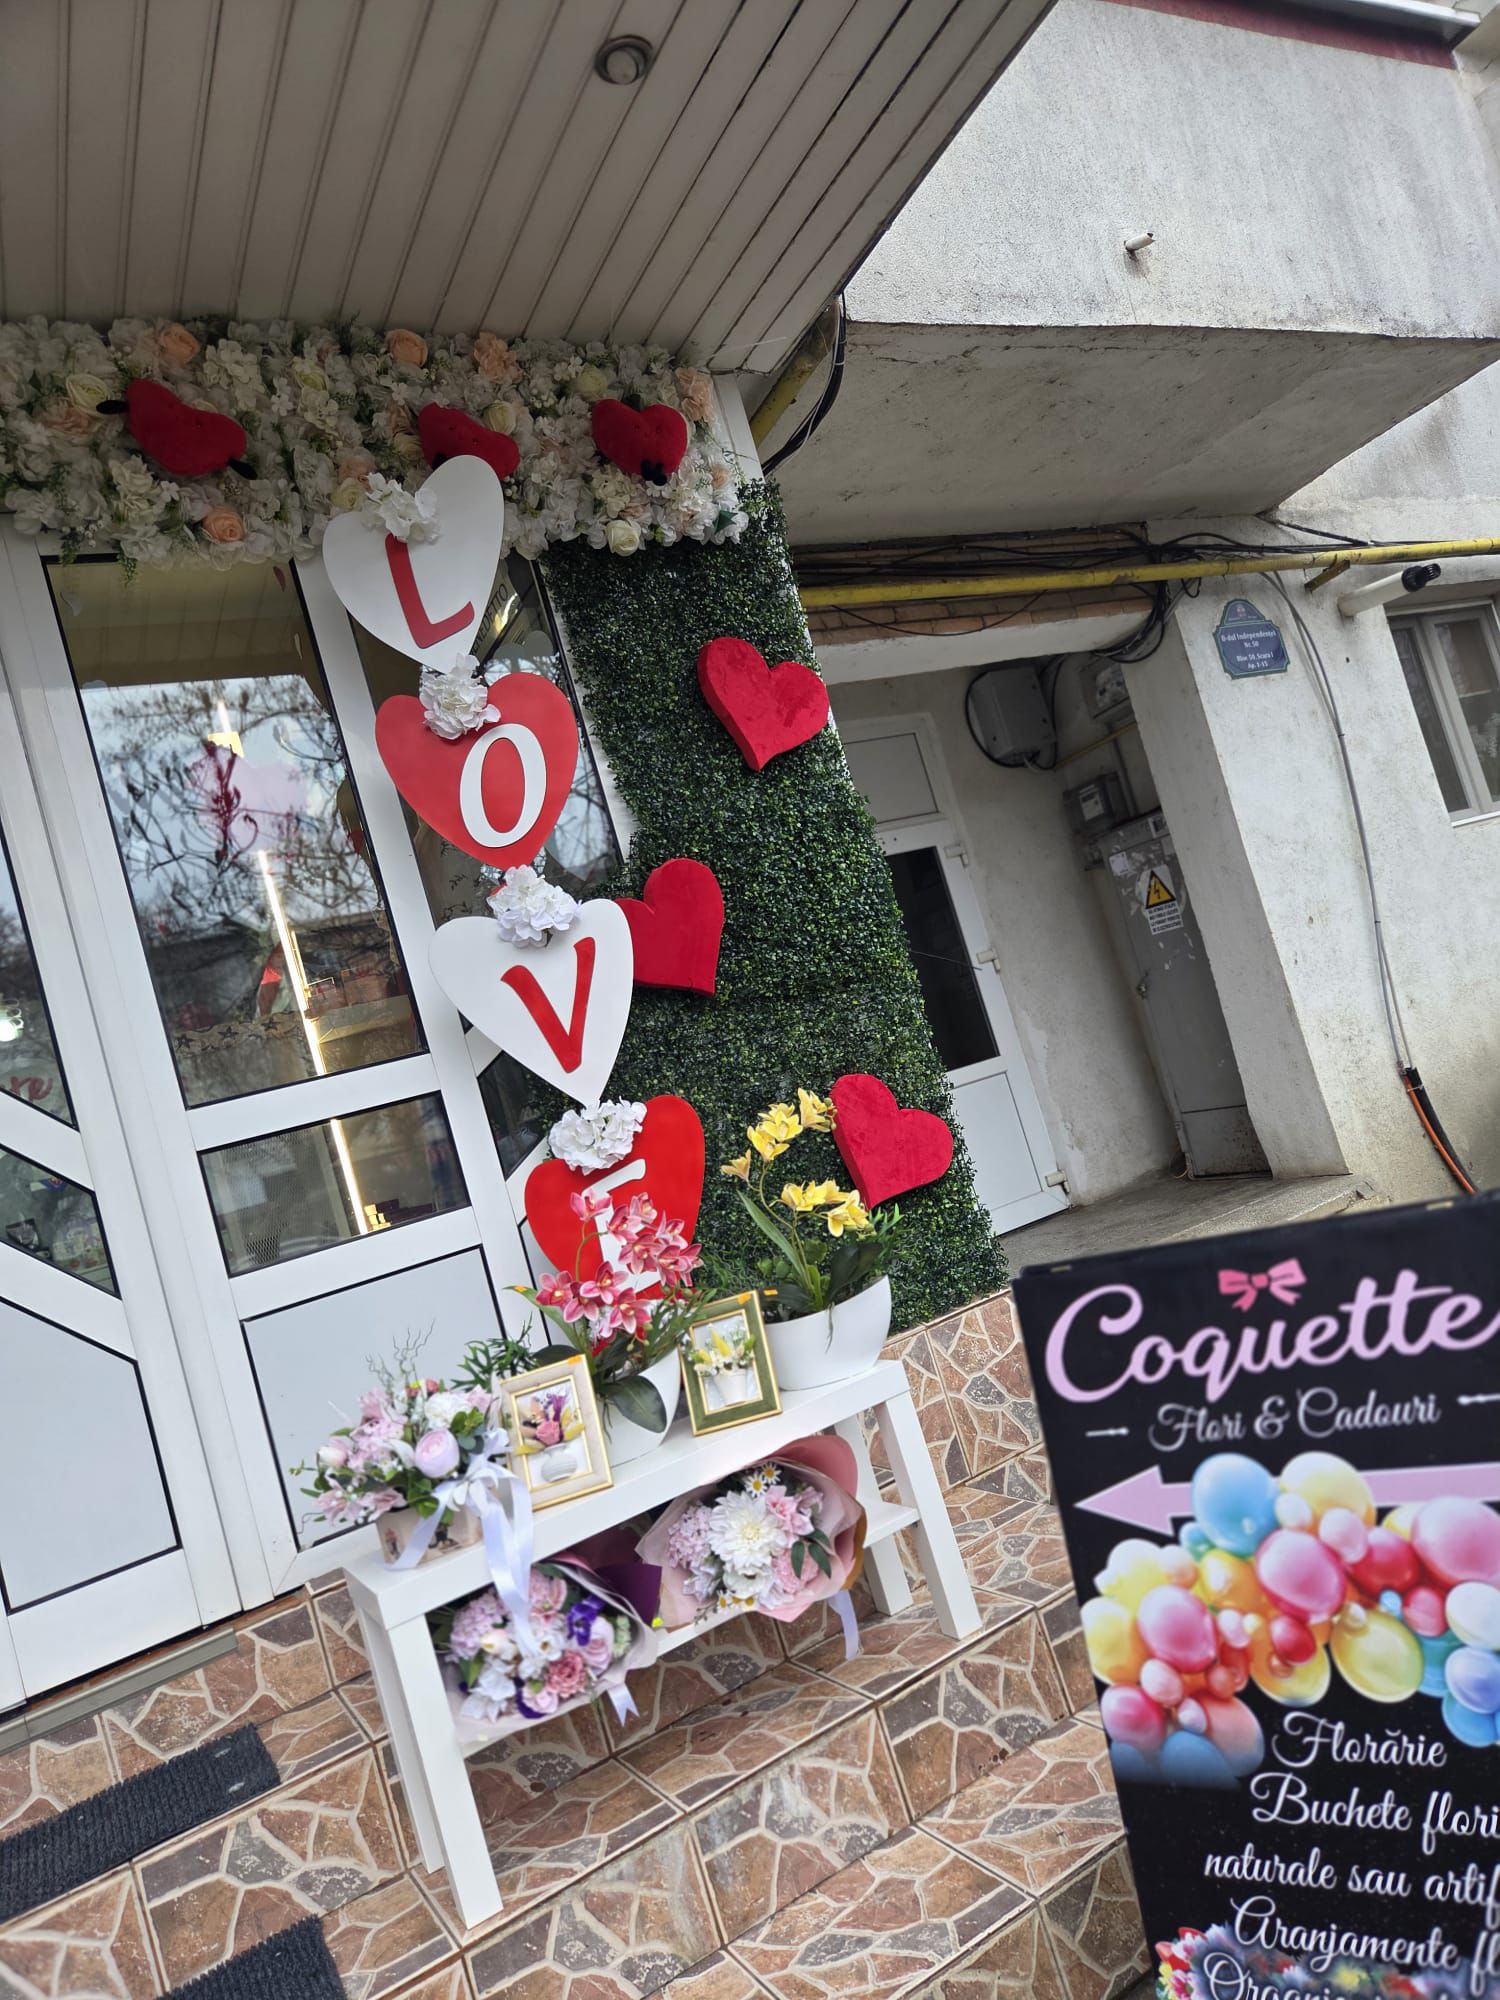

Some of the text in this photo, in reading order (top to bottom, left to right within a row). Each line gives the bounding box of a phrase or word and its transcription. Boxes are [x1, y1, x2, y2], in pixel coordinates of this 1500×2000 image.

[1045, 1270, 1500, 1403] Coquette
[1148, 1386, 1442, 1452] Flori & Cadouri
[1271, 1711, 1448, 1768] Florărie
[1249, 1772, 1500, 1855] Buchete flori
[1203, 1842, 1337, 1889] naturale
[1347, 1864, 1412, 1897] sau
[1229, 1896, 1461, 1972] Aranjamente
